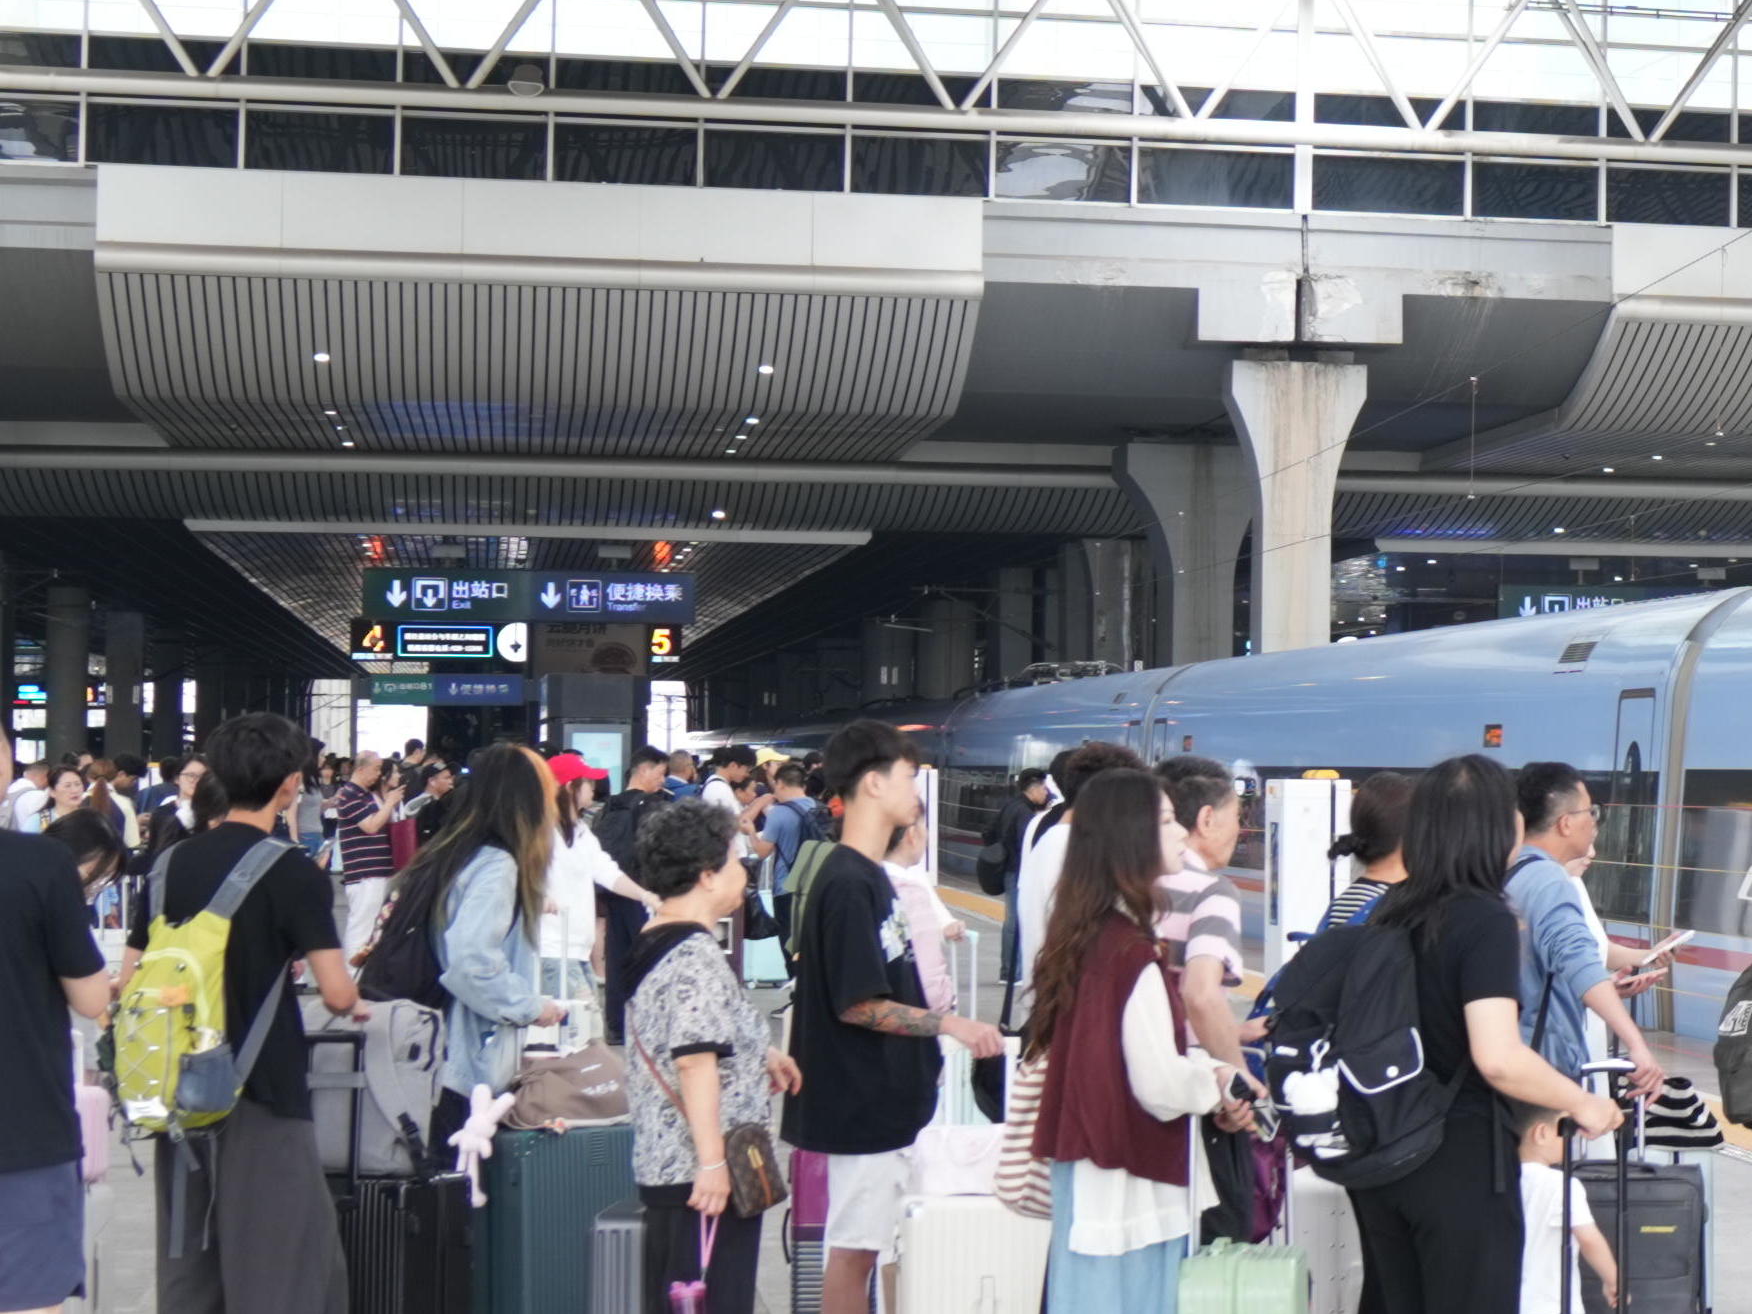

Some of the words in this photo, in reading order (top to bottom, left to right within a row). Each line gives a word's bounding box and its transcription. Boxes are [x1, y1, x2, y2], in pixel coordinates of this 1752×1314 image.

[452, 580, 508, 599] 出站口
[606, 582, 683, 602] 便捷换乘
[452, 600, 472, 610] Exit
[651, 628, 672, 655] 5
